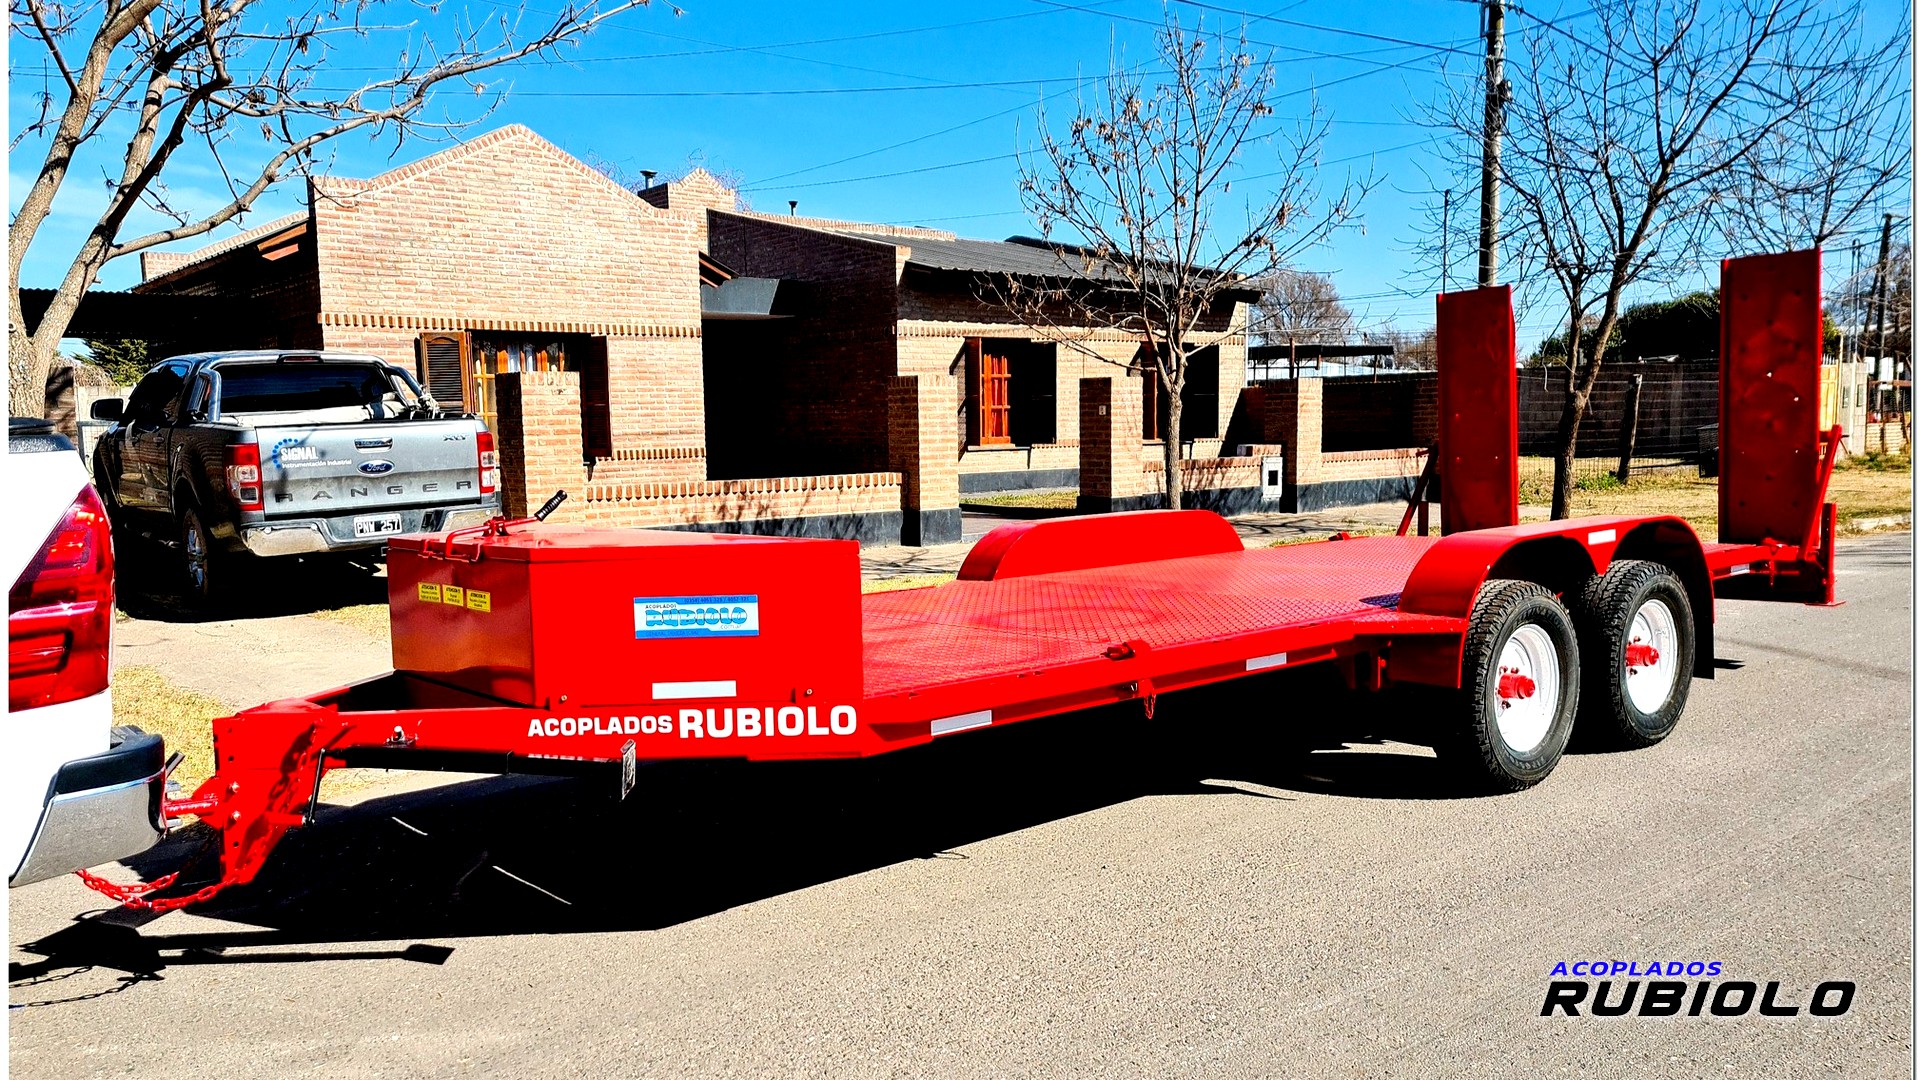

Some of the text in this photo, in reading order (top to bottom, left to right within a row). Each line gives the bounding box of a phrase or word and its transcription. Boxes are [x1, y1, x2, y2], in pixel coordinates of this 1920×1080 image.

[280, 446, 319, 461] SIGNAL
[367, 463, 386, 471] Ford
[275, 480, 472, 503] RANGER
[380, 518, 400, 531] 257
[645, 606, 748, 627] RUBIOLO
[527, 705, 857, 739] ACOPLADOS RUBIOLO
